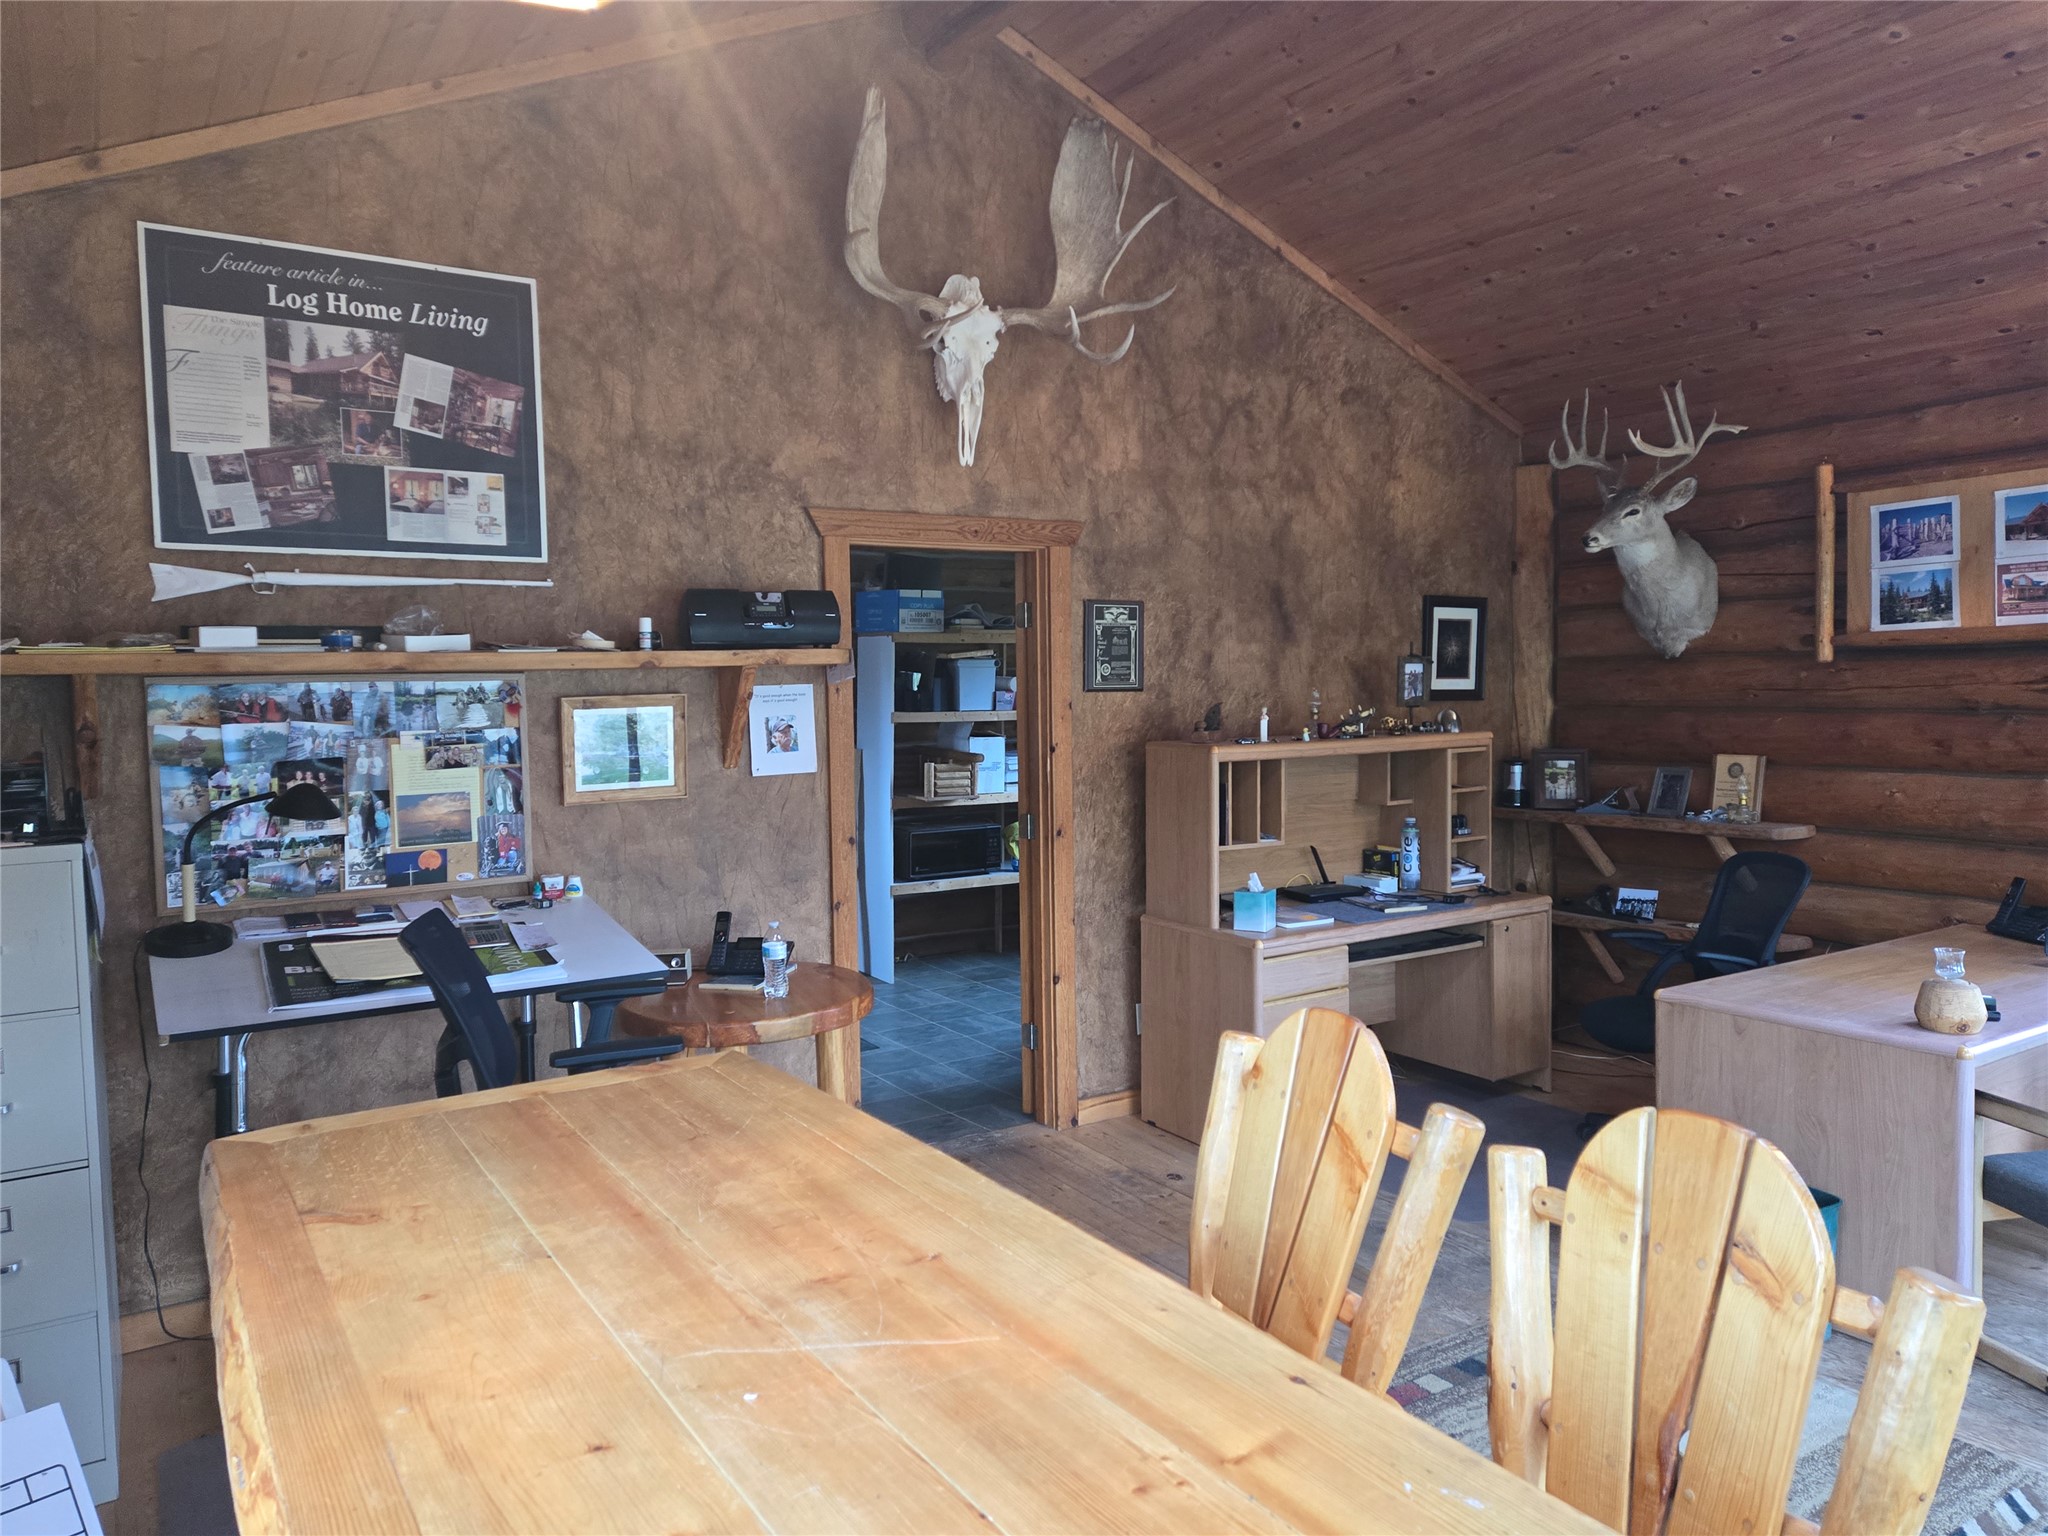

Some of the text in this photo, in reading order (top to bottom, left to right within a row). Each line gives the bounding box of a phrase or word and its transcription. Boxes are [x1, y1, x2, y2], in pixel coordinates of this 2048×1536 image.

[201, 252, 383, 292] feature article in...
[266, 283, 489, 338] Log Home Living
[1403, 836, 1413, 873] core
